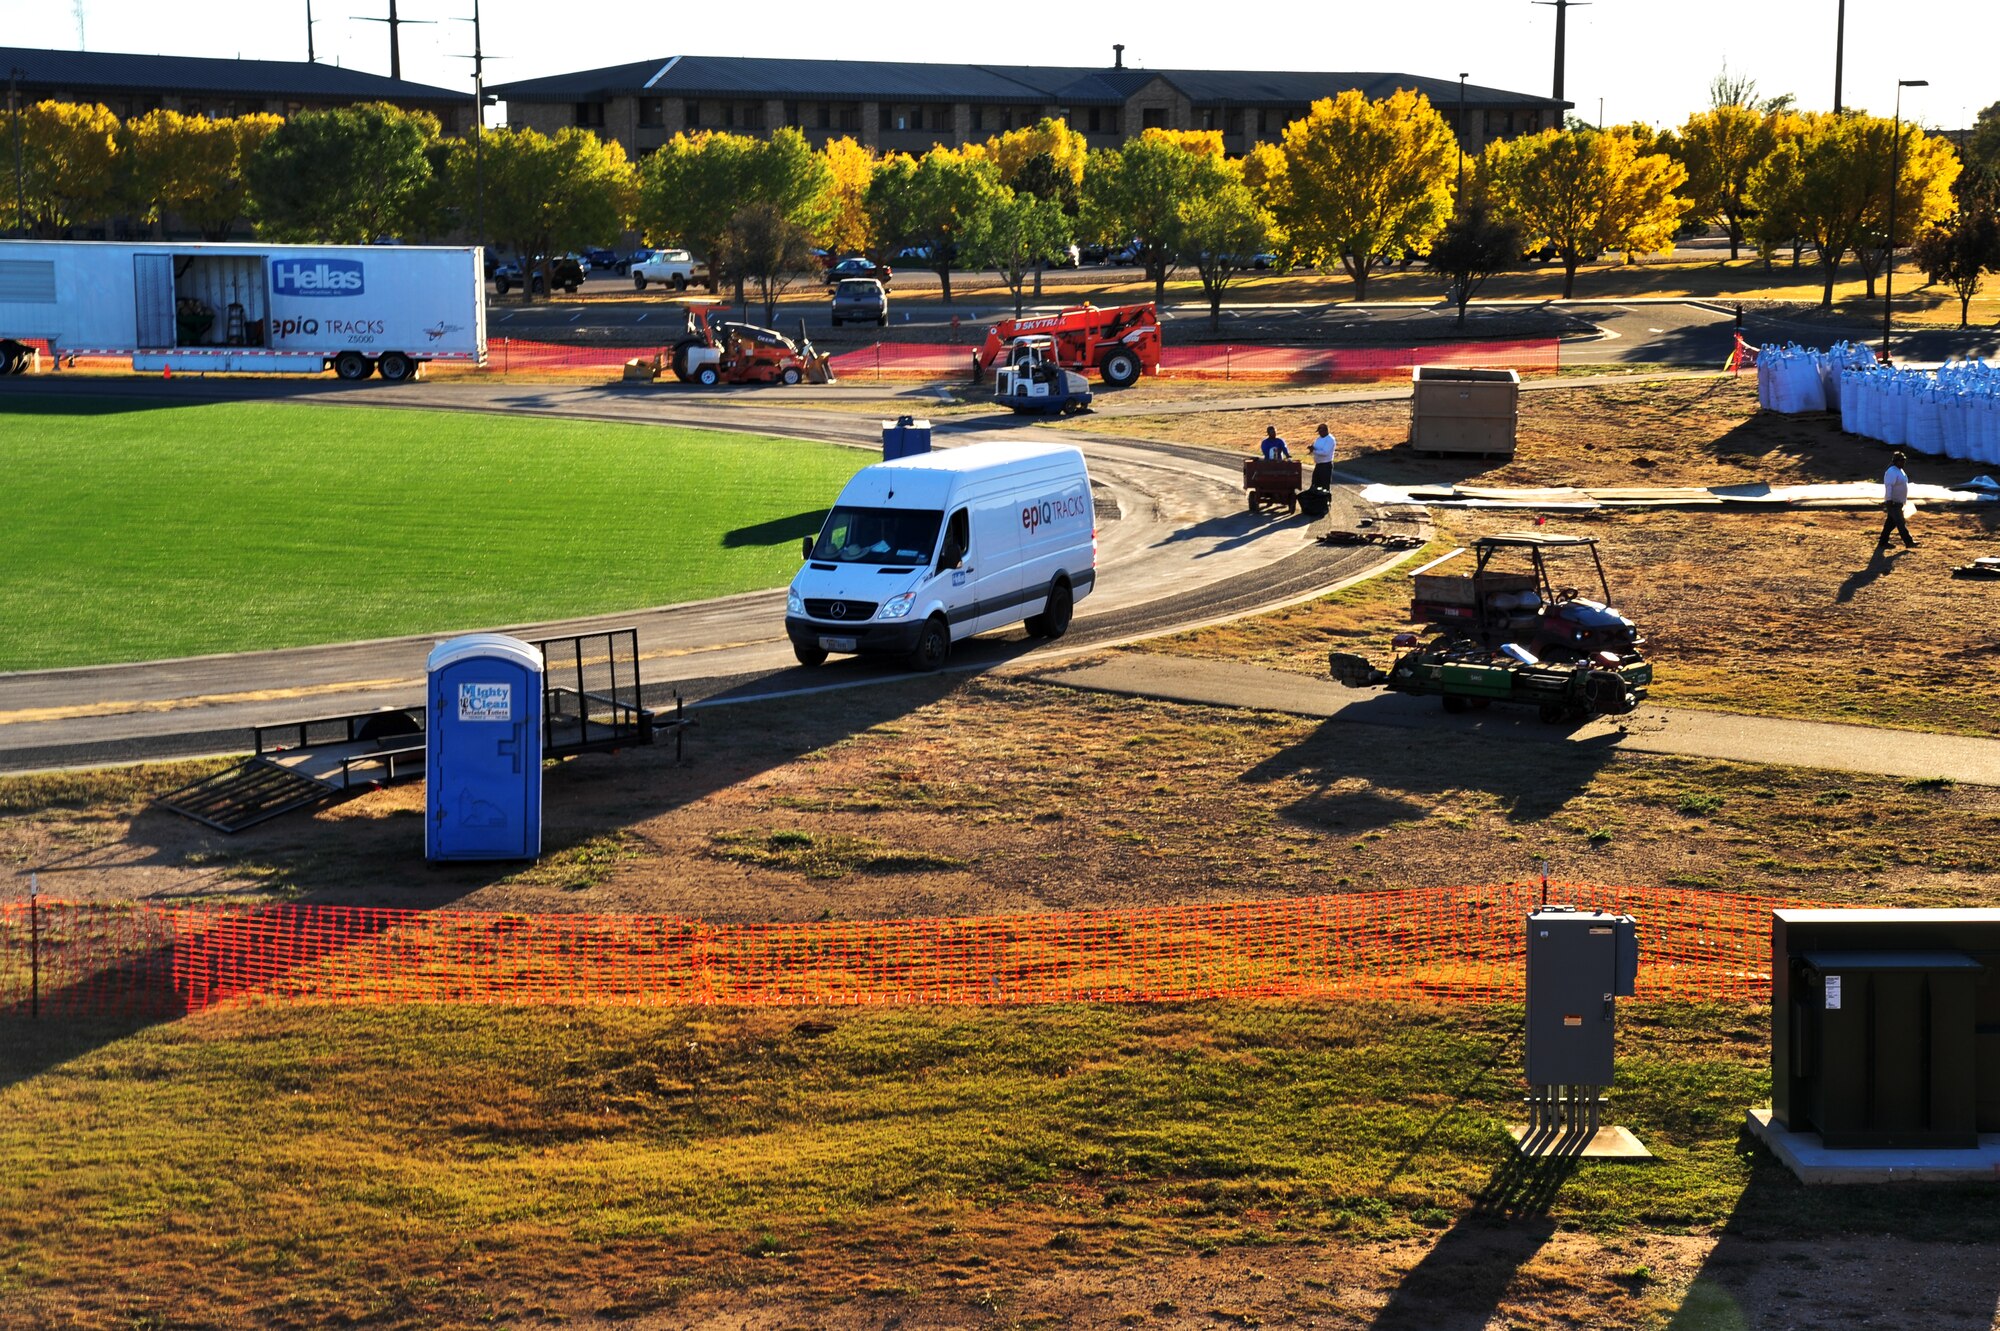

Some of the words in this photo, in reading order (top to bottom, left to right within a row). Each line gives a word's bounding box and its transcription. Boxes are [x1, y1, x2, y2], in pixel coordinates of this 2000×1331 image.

[277, 264, 362, 290] Hellas
[325, 319, 385, 335] TRACKS
[1022, 499, 1052, 535] epiQ
[1051, 496, 1085, 521] TRACKS
[462, 683, 509, 701] Mighty
[470, 698, 508, 710] Clean
